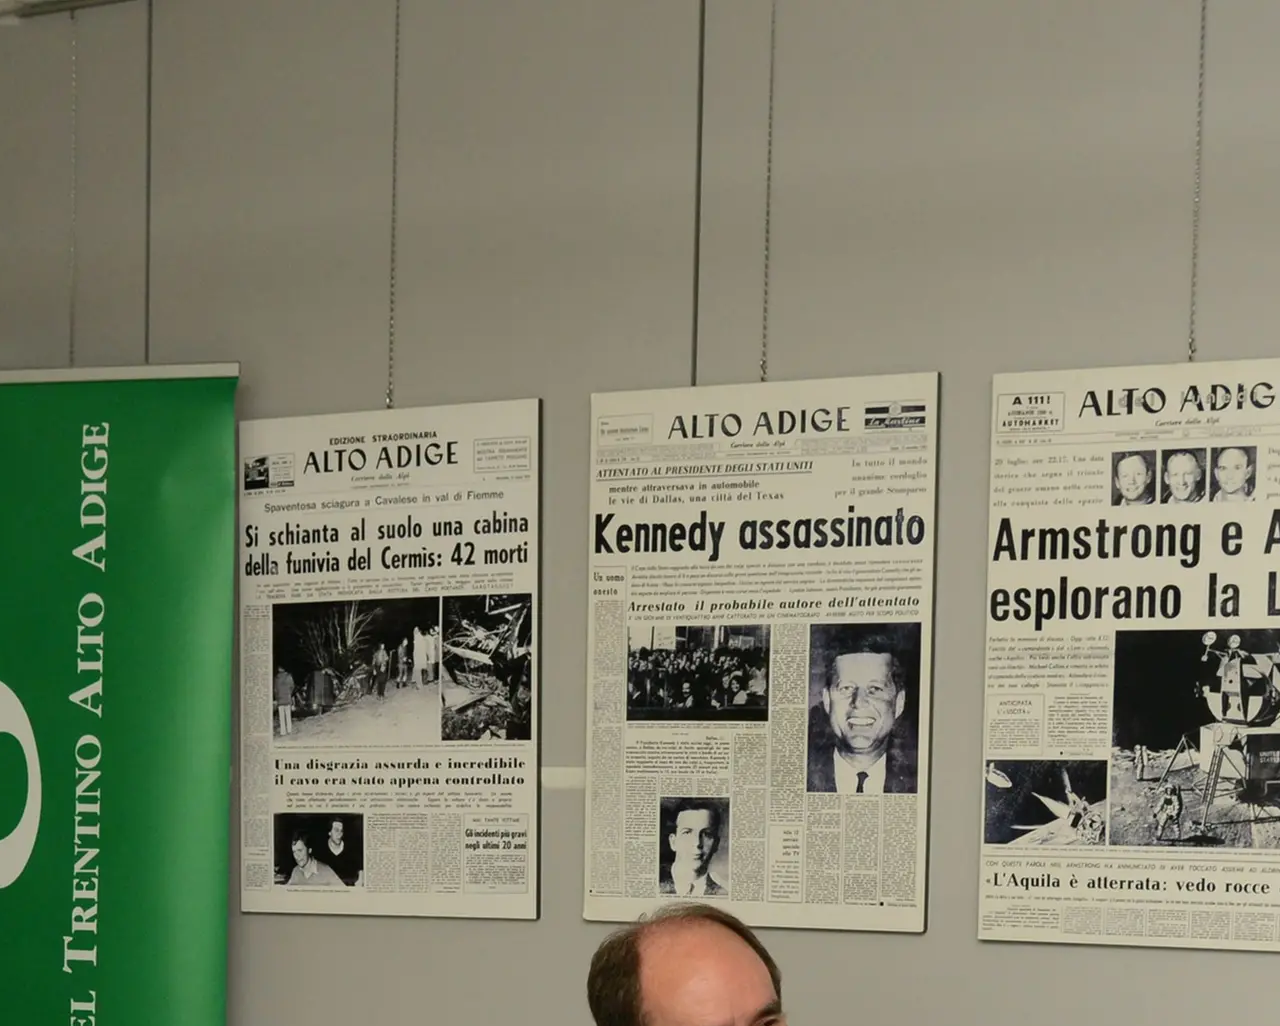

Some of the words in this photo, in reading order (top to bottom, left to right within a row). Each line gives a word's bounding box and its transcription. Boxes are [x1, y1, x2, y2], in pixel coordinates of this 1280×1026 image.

[1012, 396, 1022, 405] A
[1078, 387, 1167, 419] ALTO
[668, 413, 742, 440] ALTO
[752, 406, 851, 436] ADIGE
[329, 436, 365, 445] EDIZIONE
[372, 431, 437, 443] STRAORDINARIA
[304, 447, 367, 474] ALTO
[375, 441, 458, 470] ADIGE
[596, 466, 648, 478] ATTENTATO
[665, 464, 722, 475] PRESIDENTE
[725, 463, 754, 474] DEGLI
[756, 461, 784, 473] STATI
[786, 461, 813, 471] UNITI
[70, 422, 110, 572] ADIGE
[608, 496, 617, 505] le
[621, 495, 635, 504] vie
[639, 494, 649, 504] di
[688, 494, 707, 503] una
[737, 491, 753, 501] del
[755, 490, 784, 500] Texas
[609, 485, 638, 494] mentre
[642, 481, 695, 492] attraversava
[698, 481, 708, 490] in
[711, 479, 760, 490] automobile
[264, 501, 316, 514] Spaventosa
[321, 499, 360, 511] sciagura
[364, 499, 370, 507] a
[375, 494, 417, 506] Cavalese
[423, 492, 430, 503] in
[435, 492, 449, 502] val
[454, 490, 463, 501] di
[467, 489, 504, 500] Fiemme
[245, 524, 258, 548] Si
[269, 520, 339, 546] schianta
[350, 517, 365, 541] al
[377, 514, 422, 540] suolo
[433, 519, 463, 537] una
[474, 510, 529, 534] cabina
[593, 510, 726, 562] Kennedy
[738, 505, 925, 551] assassinato
[993, 517, 1202, 569] Armstrong
[1221, 520, 1243, 556] e
[245, 553, 279, 576] della
[286, 550, 339, 575] funivia
[348, 548, 371, 572] del
[451, 542, 475, 566] 42
[484, 541, 528, 565] morti
[628, 601, 686, 614] Arrestato
[695, 600, 705, 612] il
[710, 599, 774, 613] probabile
[779, 598, 823, 610] autore
[827, 596, 920, 608] dell'attentato
[989, 576, 1182, 631] esplorano
[1208, 573, 1241, 618] la
[67, 592, 106, 717] ALTO
[275, 759, 300, 770] Una
[306, 758, 368, 771] disgrazia
[375, 758, 429, 770] assurda
[435, 761, 442, 770] e
[448, 758, 526, 770] incredibile
[275, 775, 283, 786] il
[290, 776, 319, 786] cavo
[324, 776, 345, 785] era
[351, 775, 384, 785] stato
[390, 776, 439, 788] appena
[445, 774, 525, 786] controllato
[63, 735, 102, 972] TRENTINO
[502, 840, 511, 850] 20
[1069, 873, 1079, 888] è
[1087, 874, 1167, 892] atterrata:
[1176, 876, 1216, 893] vedo
[1225, 881, 1271, 895] rocce
